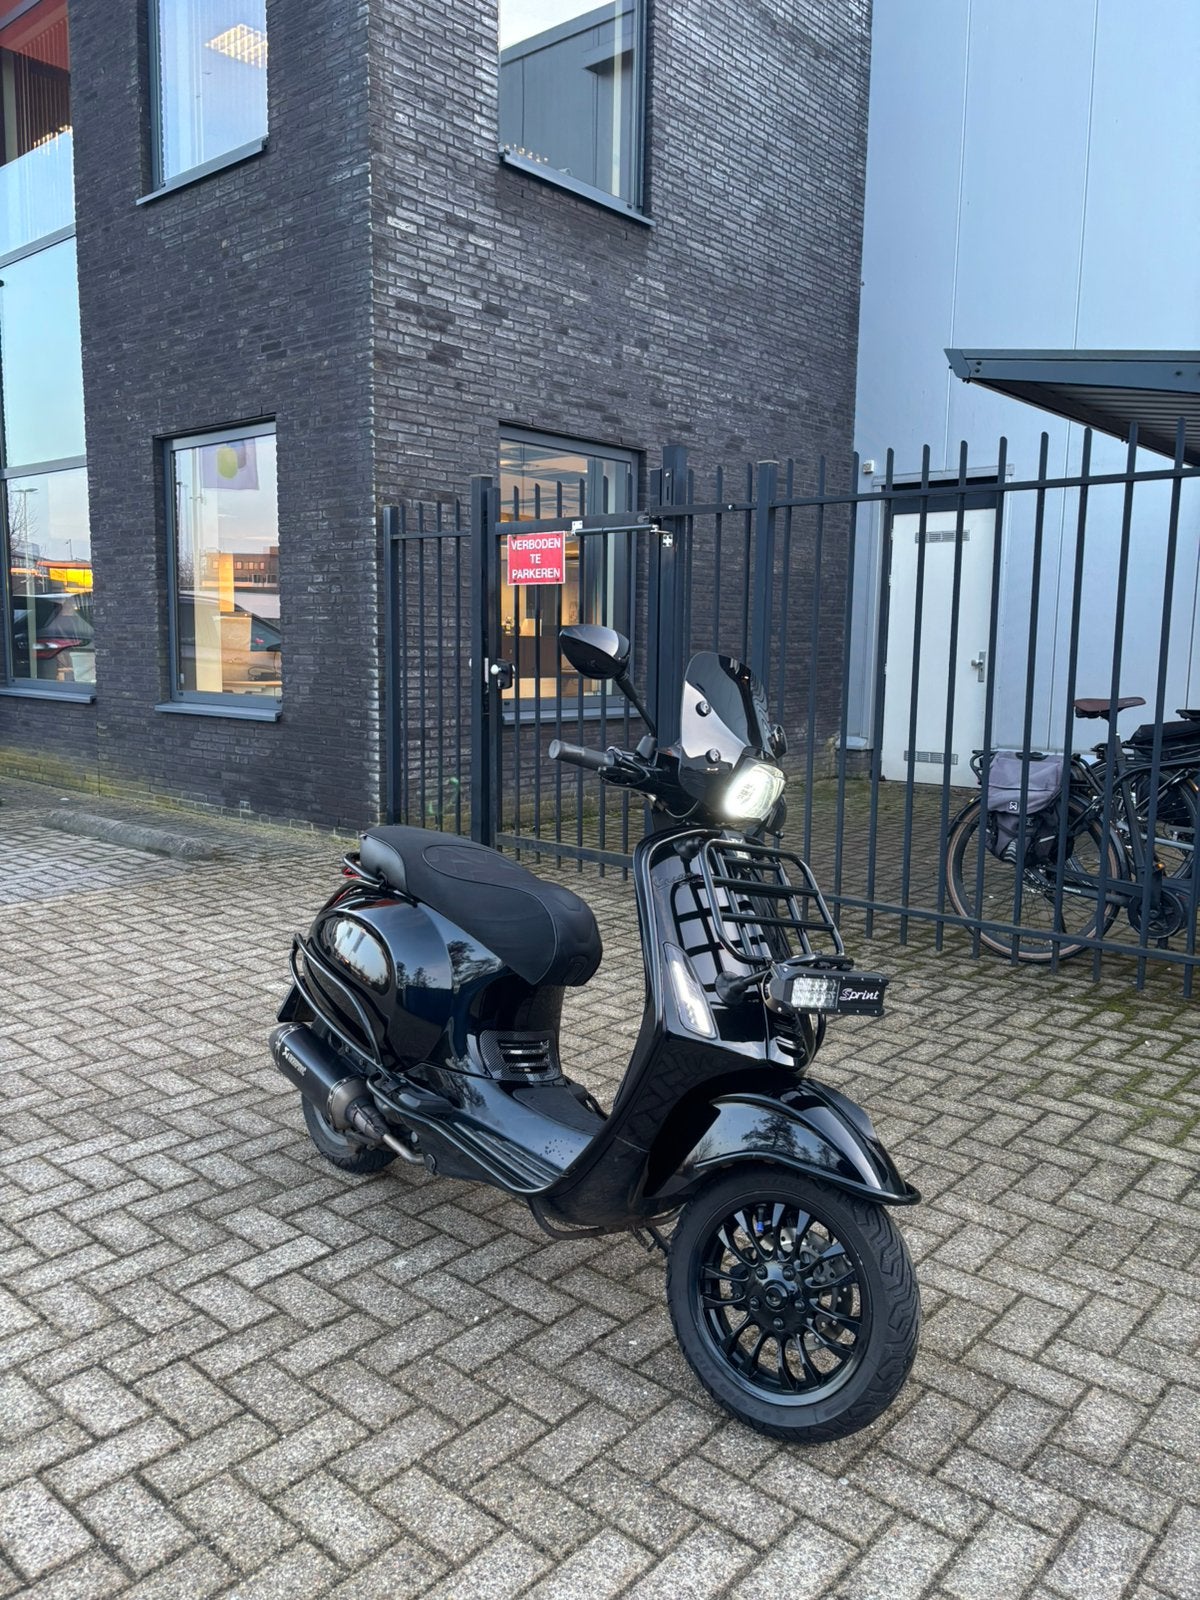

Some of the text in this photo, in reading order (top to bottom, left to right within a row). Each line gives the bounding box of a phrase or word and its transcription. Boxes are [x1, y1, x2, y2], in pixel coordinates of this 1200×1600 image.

[511, 537, 561, 550] VERBODEN
[530, 553, 541, 564] TE
[511, 567, 561, 579] PARKEREN
[839, 987, 880, 1001] Sprint
